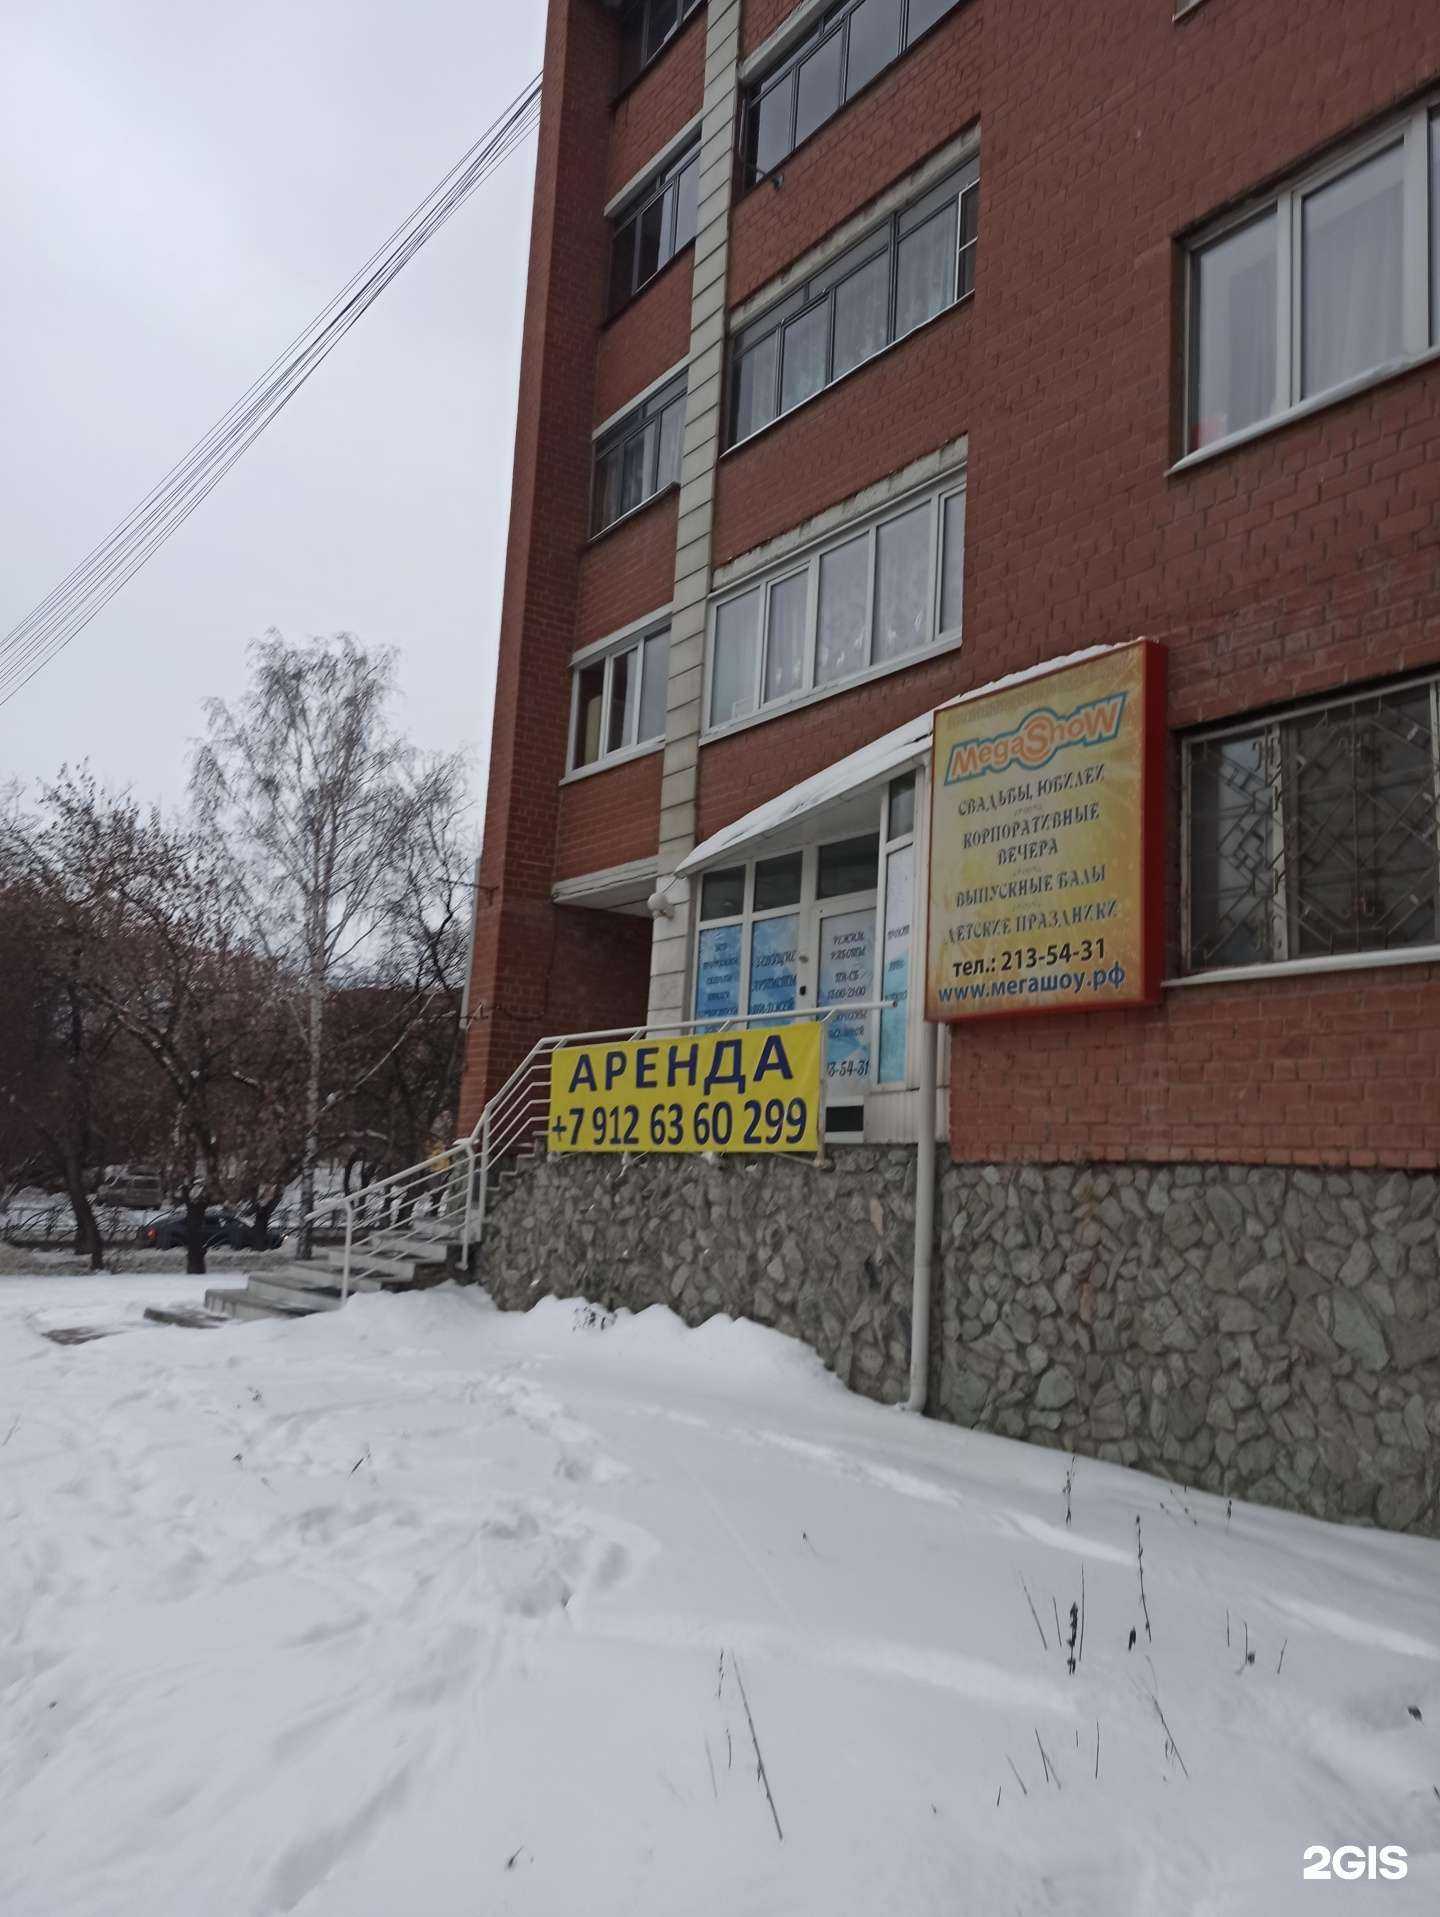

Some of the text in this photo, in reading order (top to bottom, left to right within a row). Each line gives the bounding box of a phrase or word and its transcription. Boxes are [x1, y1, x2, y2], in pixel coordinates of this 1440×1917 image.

[963, 801, 1101, 849] КОРПОРАТИВНЫЕ
[998, 838, 1059, 866] ВЕЧЕРА
[956, 864, 1107, 909] ВЫПУСКНЫЕ БАЛЫ
[945, 917, 1012, 946] ДЕТСКИЕ
[1016, 899, 1120, 933] ПРАЗДНИКИ
[952, 937, 1106, 978] тел.: 213-54-31
[938, 961, 1126, 1002] www.мегашоу.рф
[568, 1034, 794, 1096] АРЕНДА
[551, 1096, 808, 1146] +7 912 63 60 299
